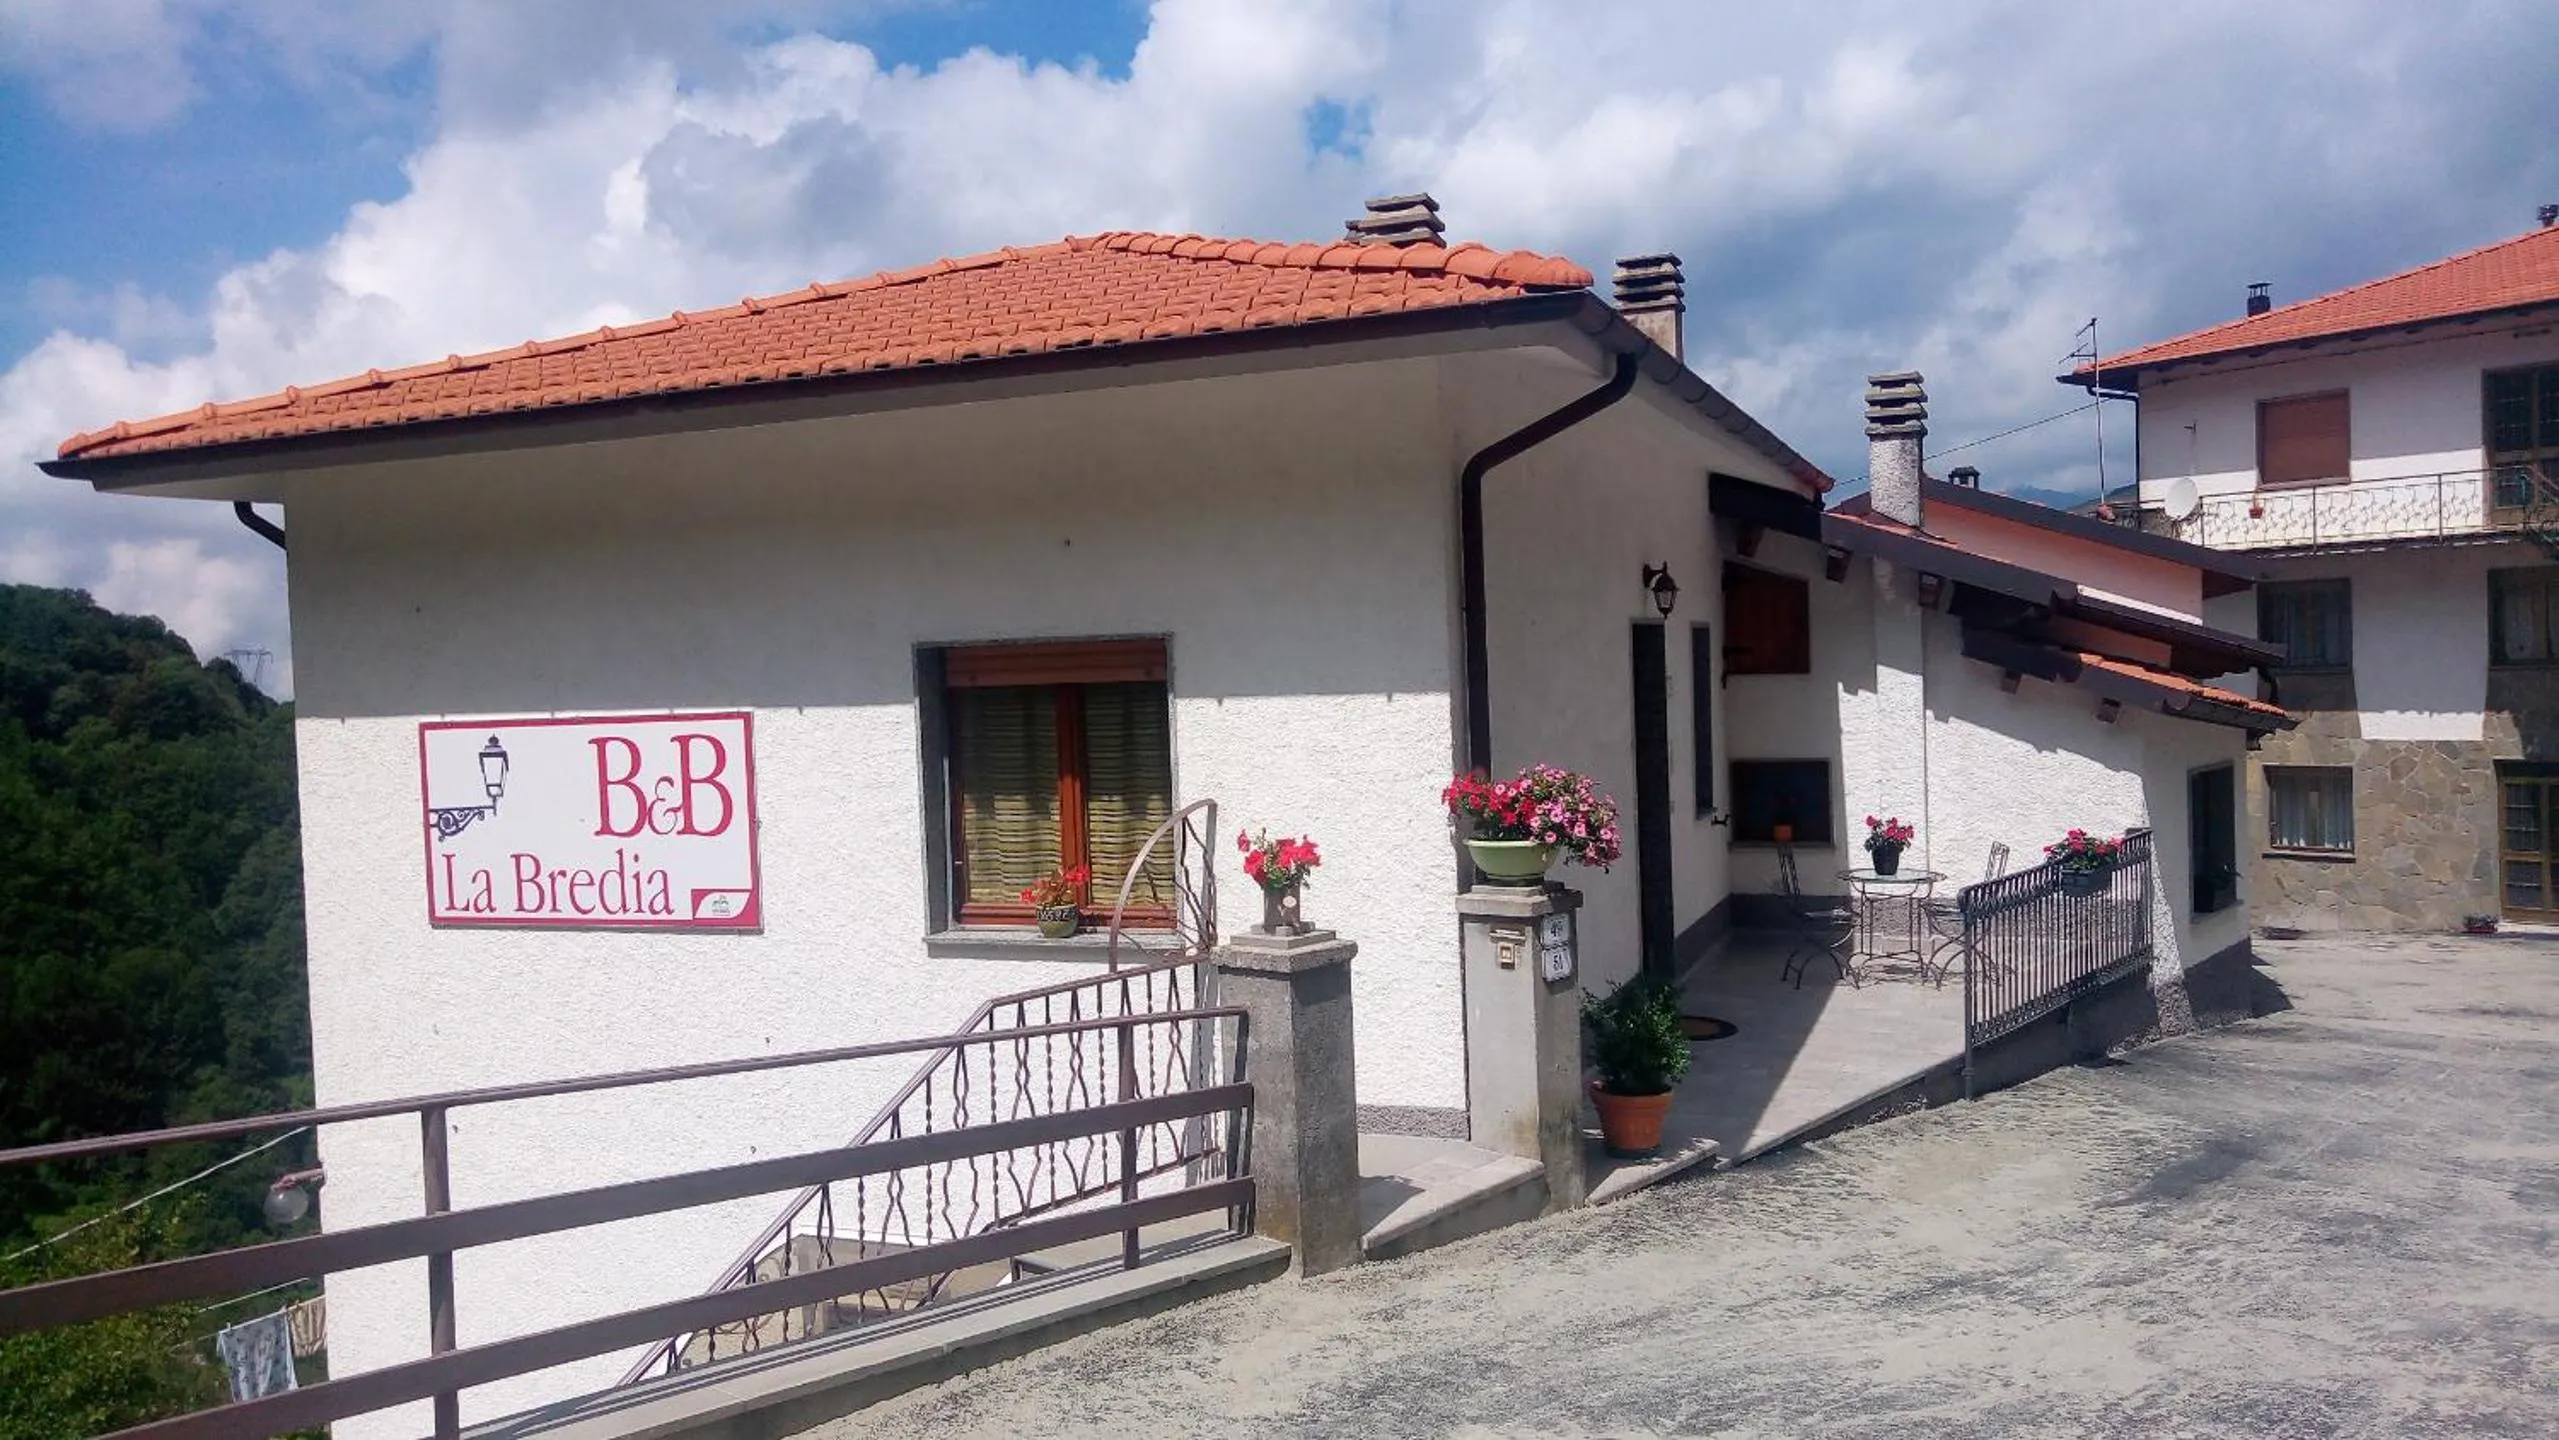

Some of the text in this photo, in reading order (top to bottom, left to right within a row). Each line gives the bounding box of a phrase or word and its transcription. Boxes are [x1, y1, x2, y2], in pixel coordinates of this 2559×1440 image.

[588, 734, 733, 837] B&B
[441, 848, 675, 916] La Bredia
